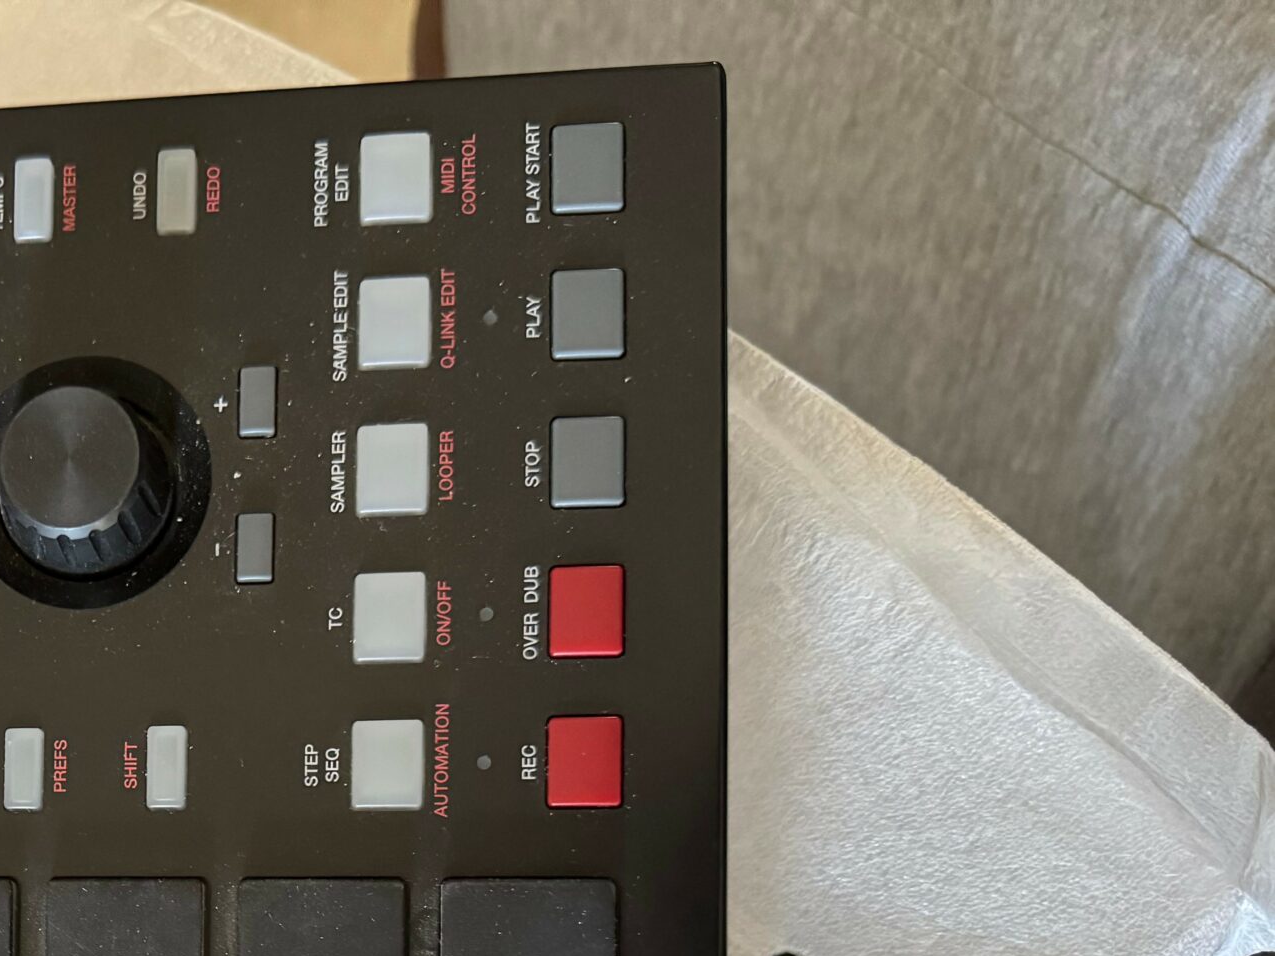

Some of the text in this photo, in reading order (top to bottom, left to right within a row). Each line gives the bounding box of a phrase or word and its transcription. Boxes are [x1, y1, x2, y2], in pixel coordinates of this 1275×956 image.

[63, 165, 76, 232] MASTER
[133, 171, 146, 220] UNDO
[206, 166, 220, 213] REDO
[314, 142, 328, 227] PROGRAM
[335, 164, 348, 202] EDIT
[441, 157, 454, 193] MIDI
[461, 134, 476, 215] CONTROL
[526, 123, 540, 223] PLAY START
[333, 270, 348, 382] SAMPLE EDIT
[441, 269, 455, 369] Q-LINK EDIT
[526, 297, 541, 338] PLAY
[331, 431, 346, 513] SAMPLER
[439, 430, 454, 501] LOOPER
[525, 440, 540, 488] STOP
[329, 607, 342, 630] TC
[436, 580, 451, 646] ON/OFF
[523, 566, 540, 660] OVER DUB
[54, 739, 67, 792] PREFS
[124, 742, 138, 788] SHIFT
[304, 743, 318, 787] STEP
[326, 747, 340, 783] SEQ
[434, 703, 450, 817] AUTOMATION
[521, 745, 537, 780] REC
